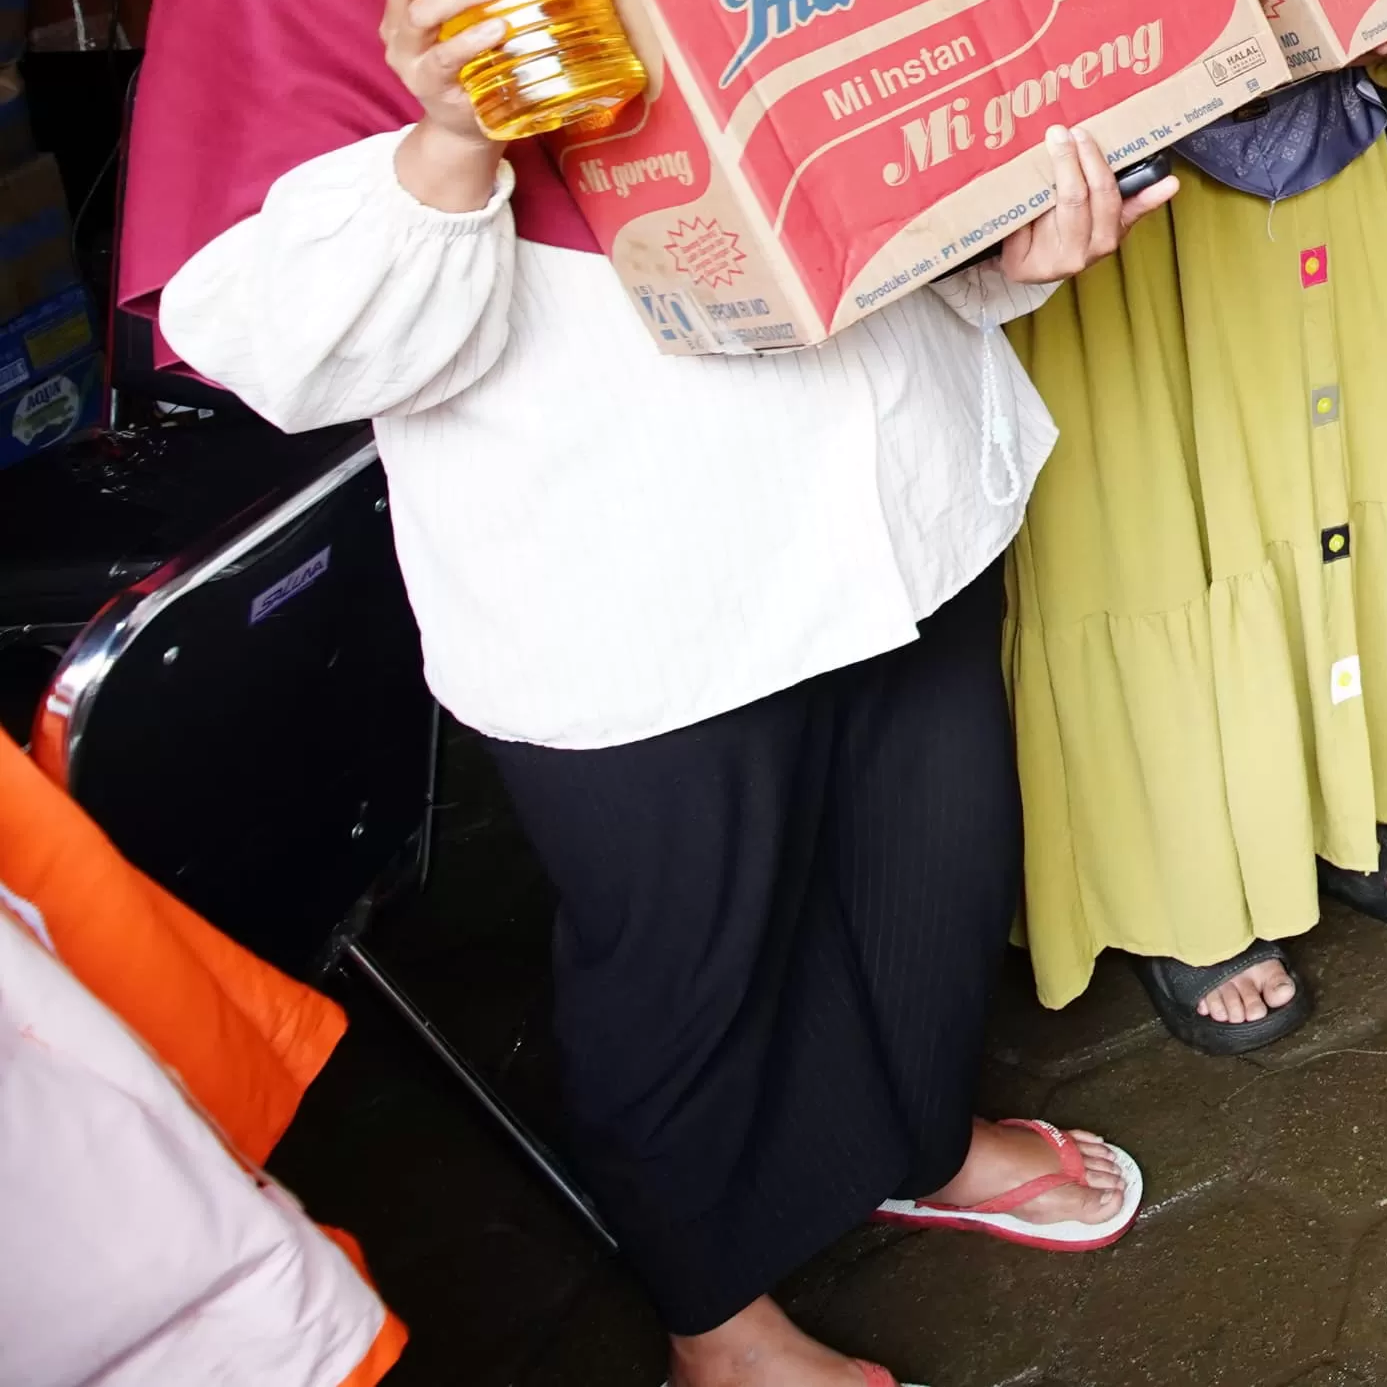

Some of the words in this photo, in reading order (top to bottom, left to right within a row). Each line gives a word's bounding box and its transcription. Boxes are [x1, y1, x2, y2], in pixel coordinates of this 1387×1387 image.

[822, 80, 871, 119] Mi
[874, 31, 976, 96] Instan
[1226, 45, 1259, 66] HALAL
[882, 107, 974, 187] Mi
[984, 18, 1164, 152] goreng
[579, 158, 612, 194] Mi
[611, 150, 694, 199] goreng
[855, 269, 911, 310] Diproduksi
[911, 257, 935, 278] oleh
[940, 243, 958, 260] PT
[960, 203, 1028, 251] INDOFOOD
[1028, 189, 1051, 209] CBP
[1106, 135, 1150, 165] AKMUR
[1150, 124, 1173, 142] Tbk
[1183, 96, 1224, 125] Indonesia
[25, 379, 62, 412] AQUA
